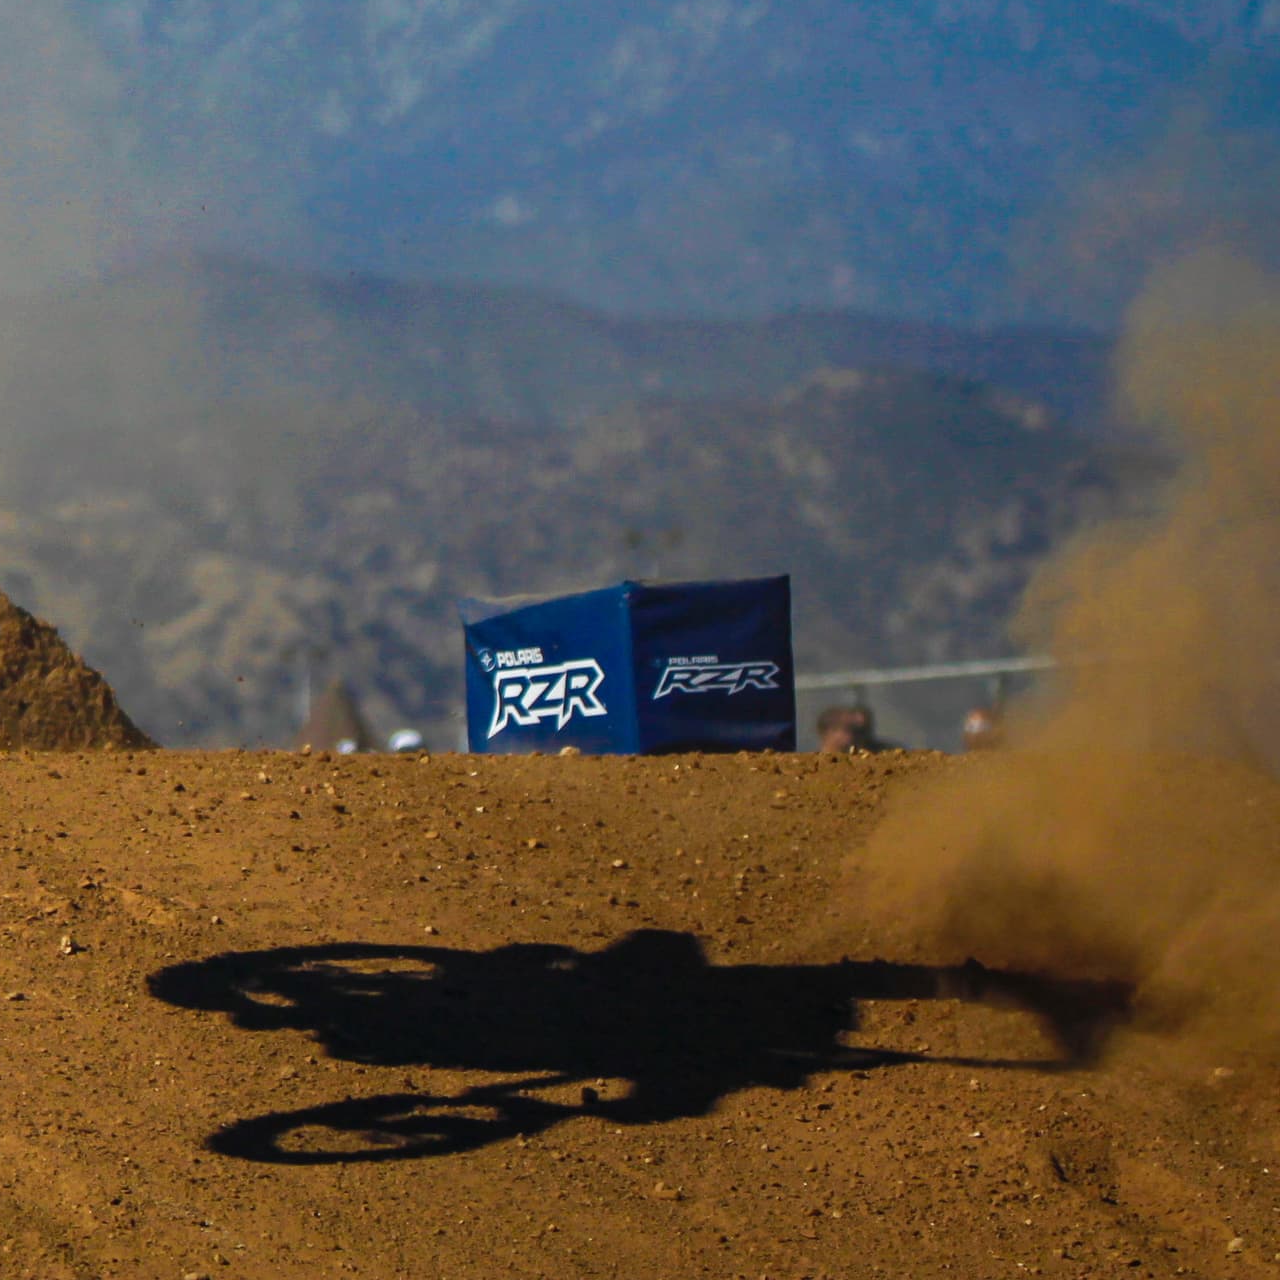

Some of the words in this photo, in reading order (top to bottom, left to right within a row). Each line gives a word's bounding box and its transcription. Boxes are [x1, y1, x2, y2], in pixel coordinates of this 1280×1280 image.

[496, 647, 543, 668] POLARIS
[668, 655, 718, 665] POLARIS
[653, 661, 780, 700] RZR
[488, 658, 607, 740] RZR
